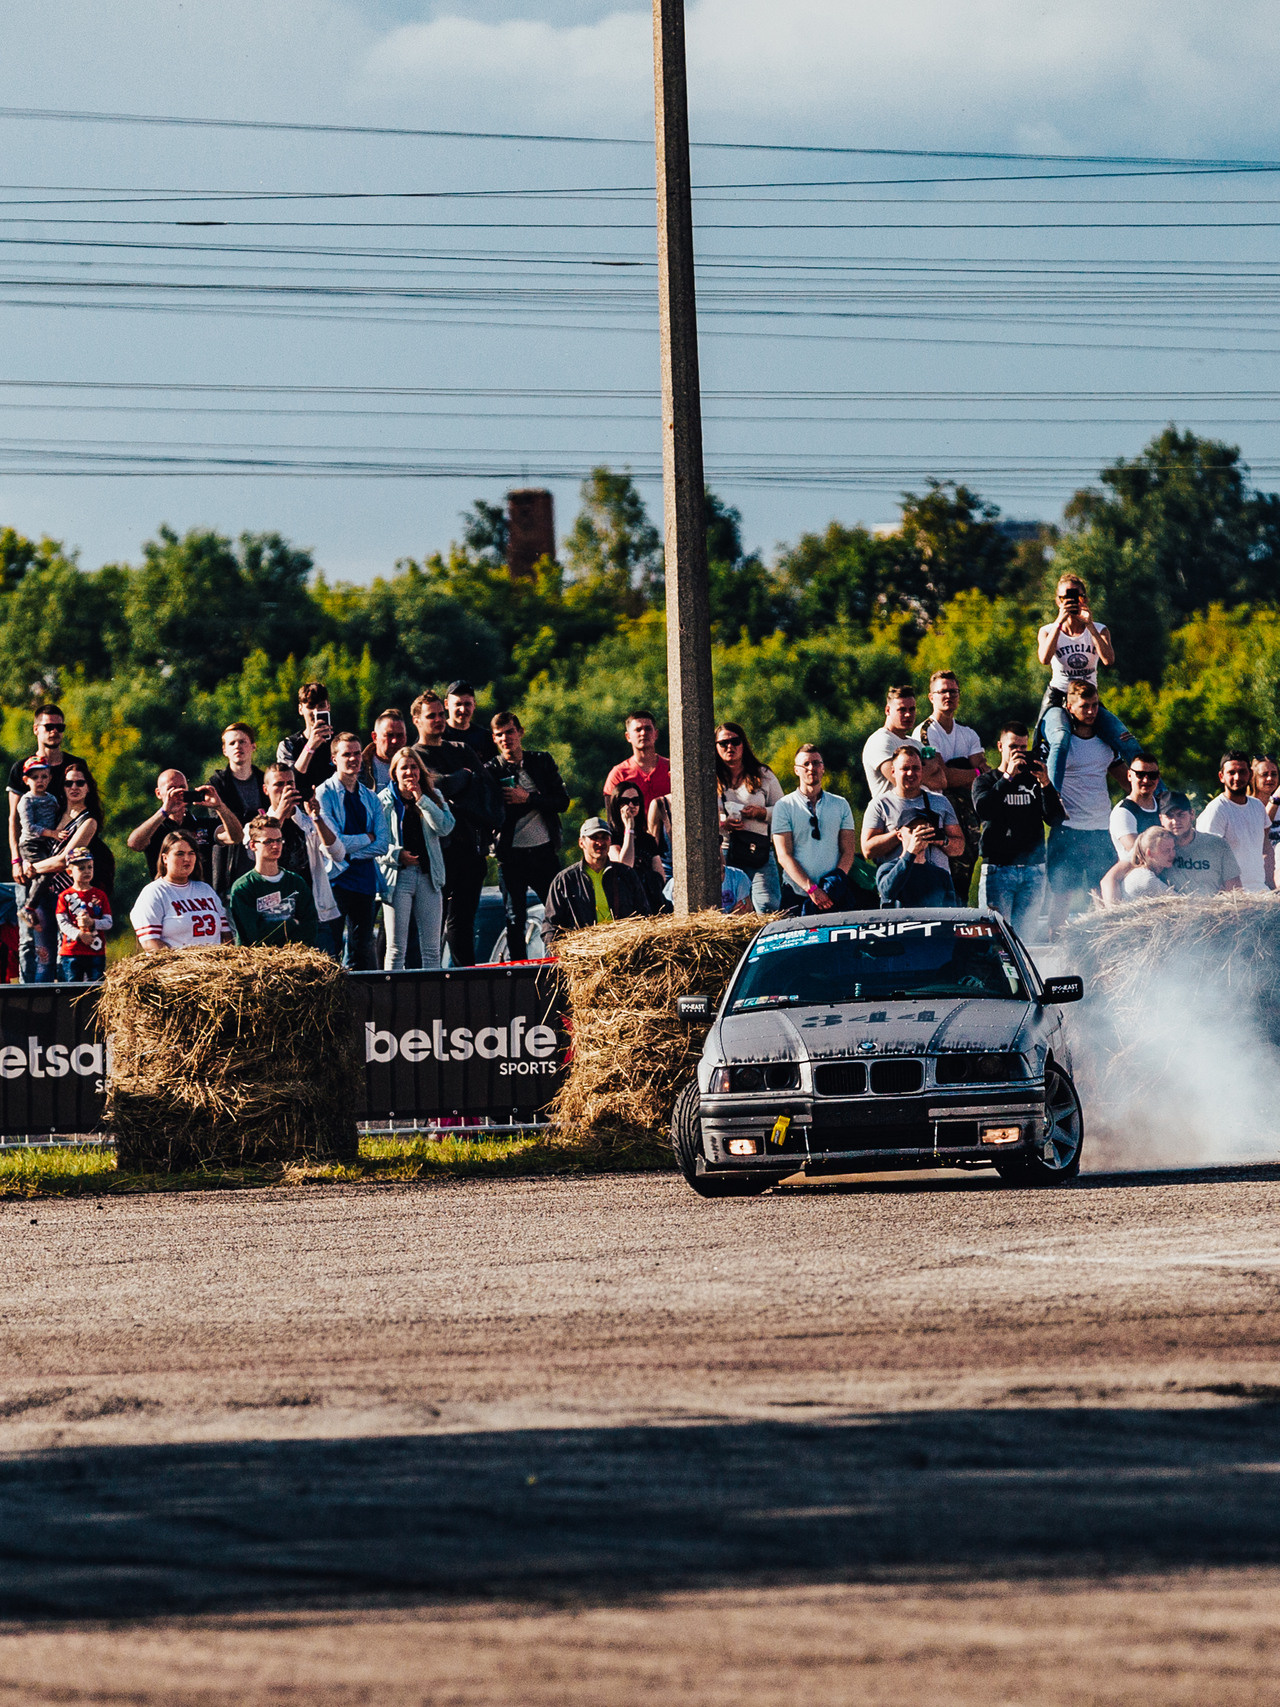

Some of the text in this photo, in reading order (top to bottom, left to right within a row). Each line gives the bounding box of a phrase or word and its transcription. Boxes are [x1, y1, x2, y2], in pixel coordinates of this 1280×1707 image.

[1056, 644, 1096, 658] OFFICIAL
[171, 898, 219, 916] MIAMI
[191, 913, 216, 937] 23
[830, 921, 942, 943] DRIFT
[801, 1010, 942, 1028] 344
[365, 1015, 557, 1063] betsafe
[0, 1036, 113, 1079] etsa
[499, 1061, 557, 1076] SPORTS
